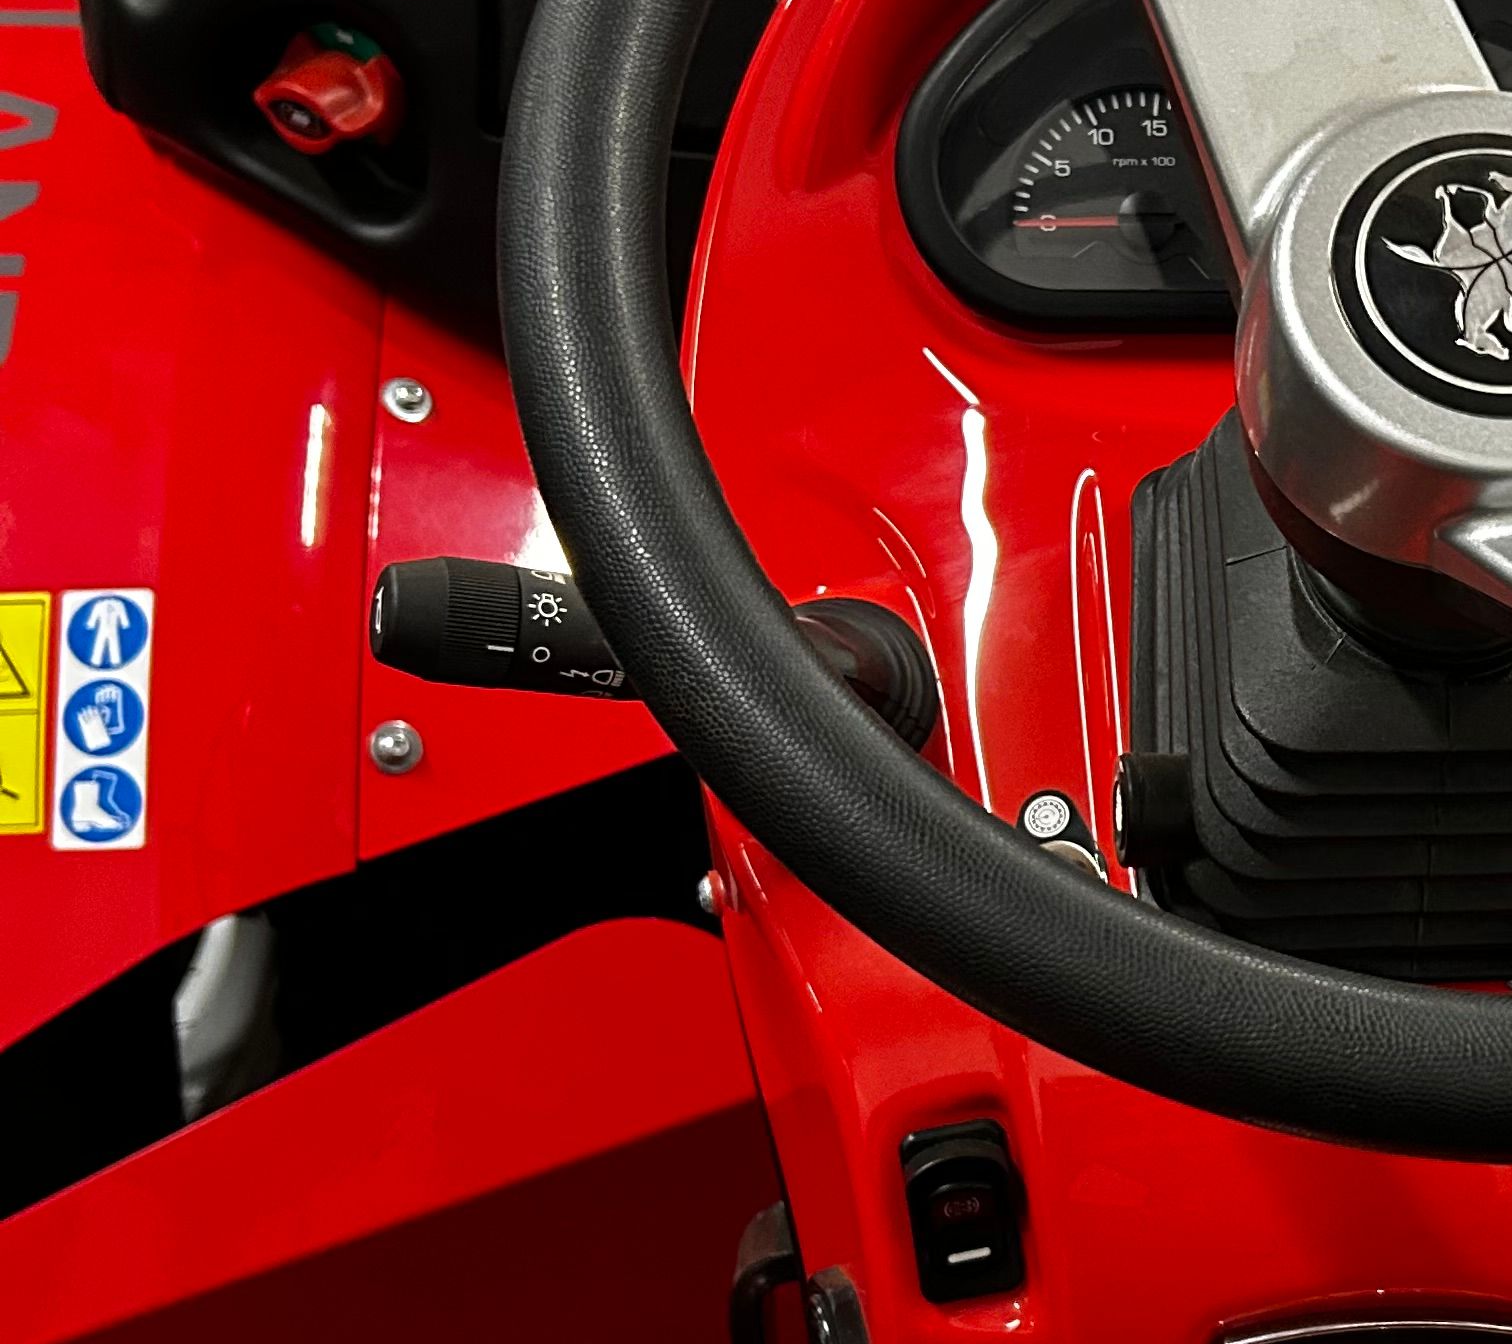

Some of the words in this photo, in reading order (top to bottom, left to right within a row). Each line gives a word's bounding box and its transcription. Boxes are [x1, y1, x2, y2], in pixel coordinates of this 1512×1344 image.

[1087, 128, 1115, 146] 10
[1140, 119, 1169, 137] 15
[1054, 159, 1072, 177] 5
[1112, 157, 1139, 168] rpm
[1151, 156, 1176, 167] 100
